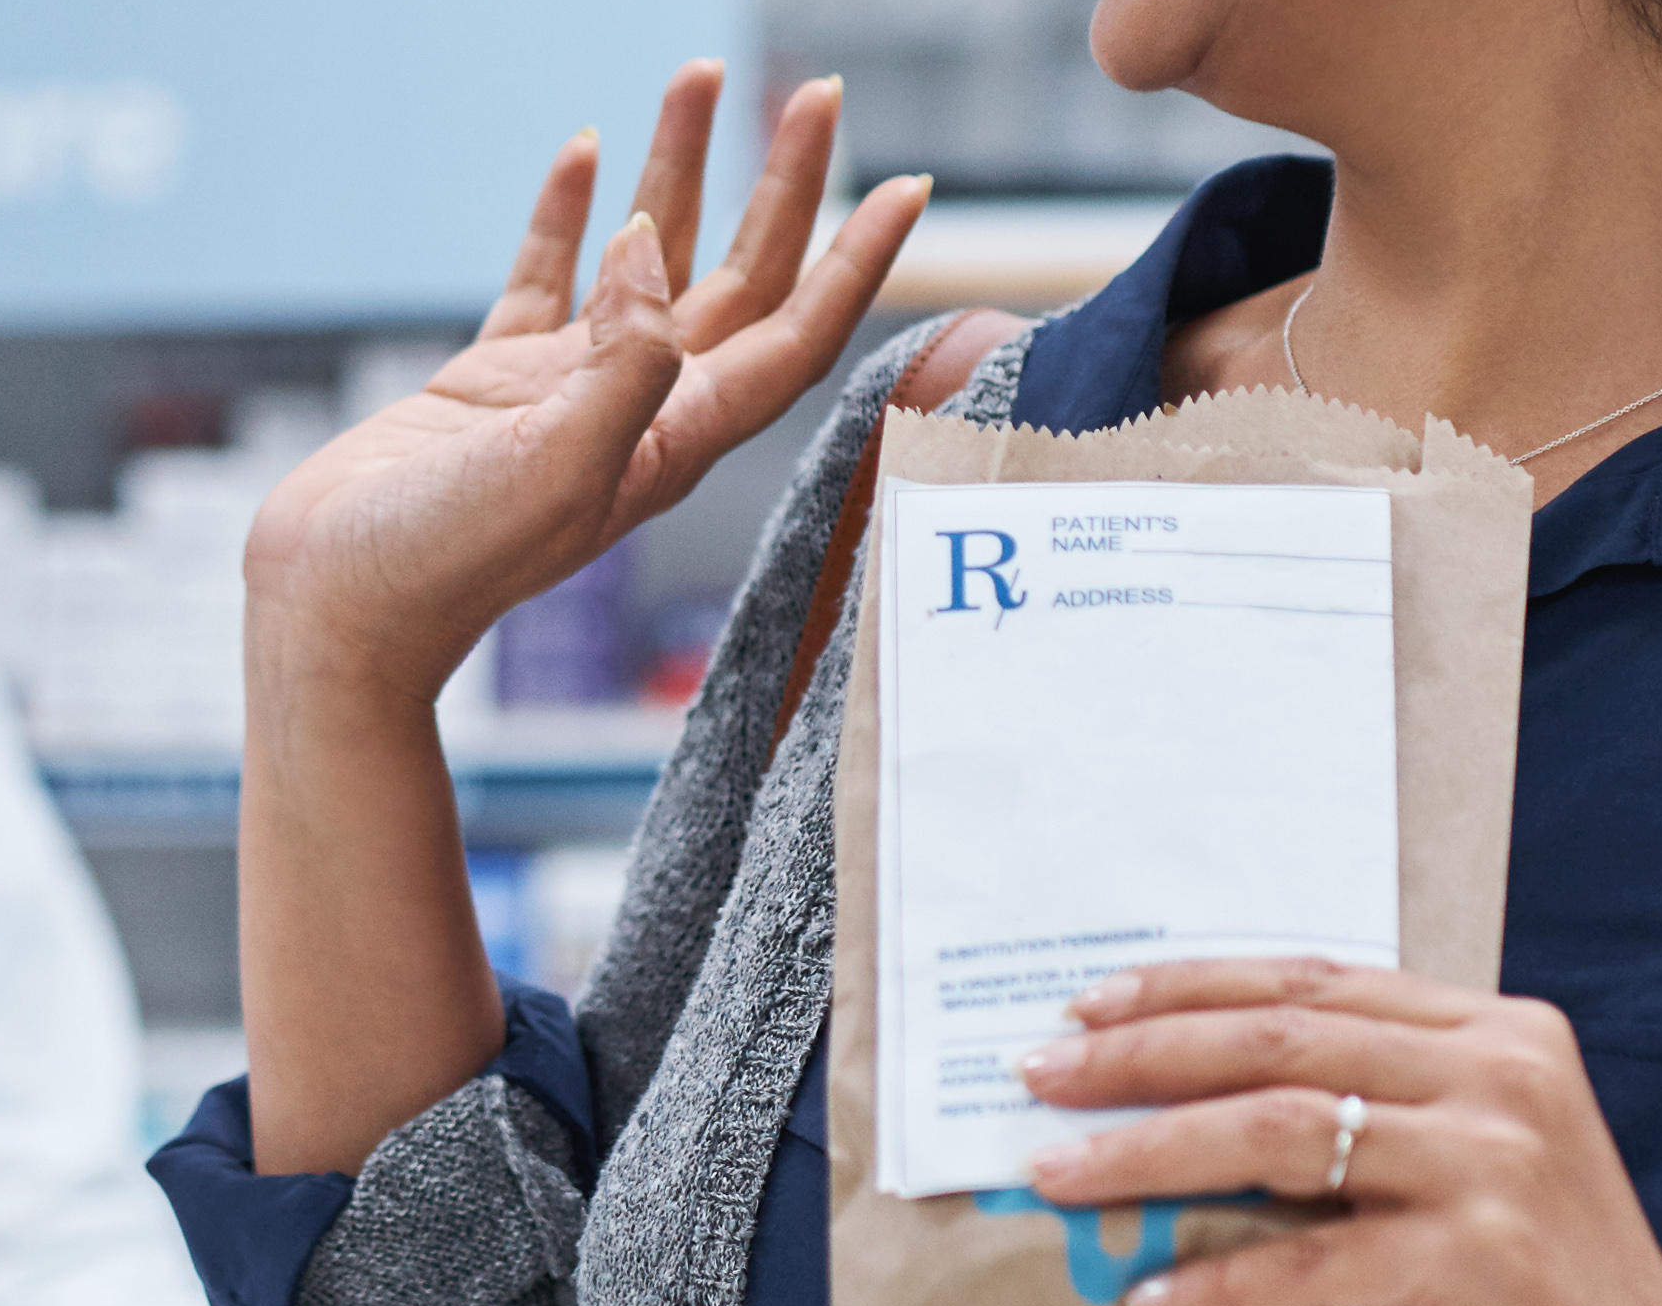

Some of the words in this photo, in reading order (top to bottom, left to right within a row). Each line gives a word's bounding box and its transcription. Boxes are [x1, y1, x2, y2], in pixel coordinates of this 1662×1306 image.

[1051, 515, 1179, 533] PATIENT'S
[1052, 535, 1124, 553] NAME
[1052, 587, 1174, 609] ADDRESS
[939, 936, 1057, 960] SUBSTITUTION
[1060, 926, 1166, 946] PERMISSIBLE
[1025, 968, 1061, 984] FOR
